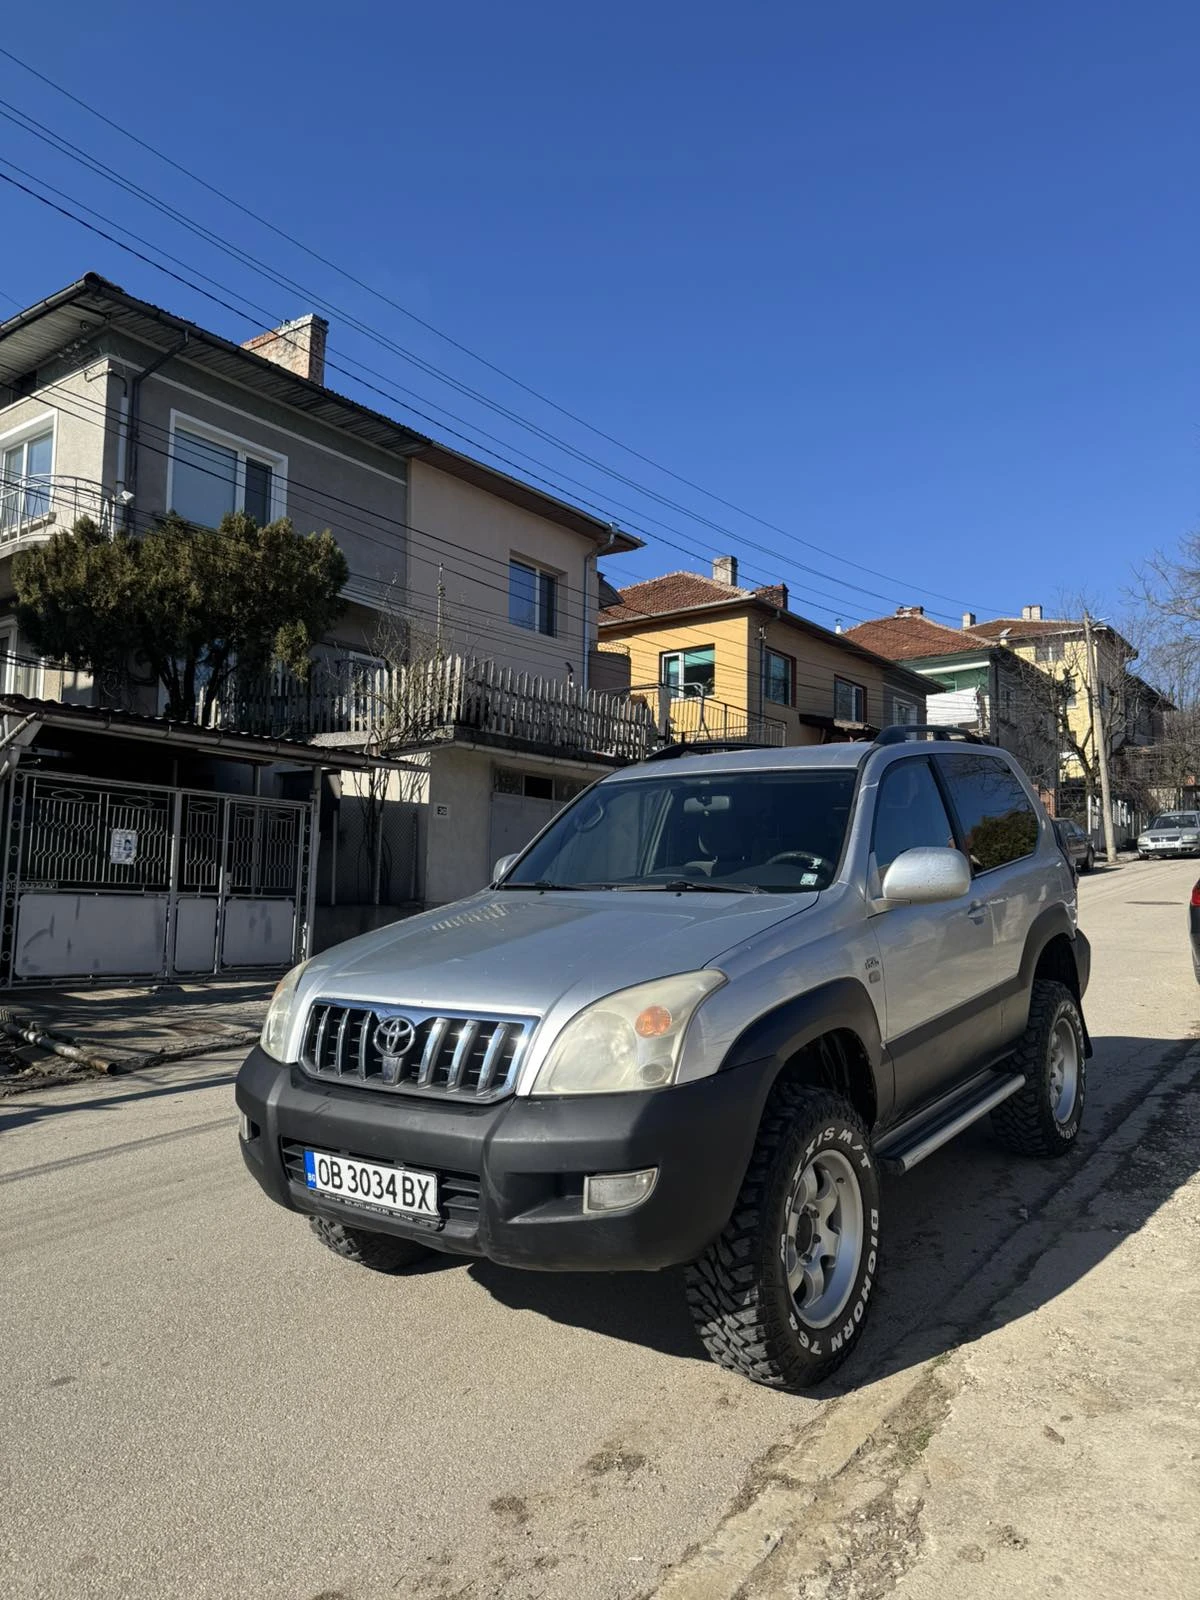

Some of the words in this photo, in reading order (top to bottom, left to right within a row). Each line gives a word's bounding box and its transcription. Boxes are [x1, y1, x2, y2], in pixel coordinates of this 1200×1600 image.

[838, 1128, 871, 1169] M/T
[318, 1158, 343, 1190] OB
[347, 1164, 398, 1204] 3034
[402, 1175, 431, 1211] BX
[830, 1208, 880, 1353] BIGHORN
